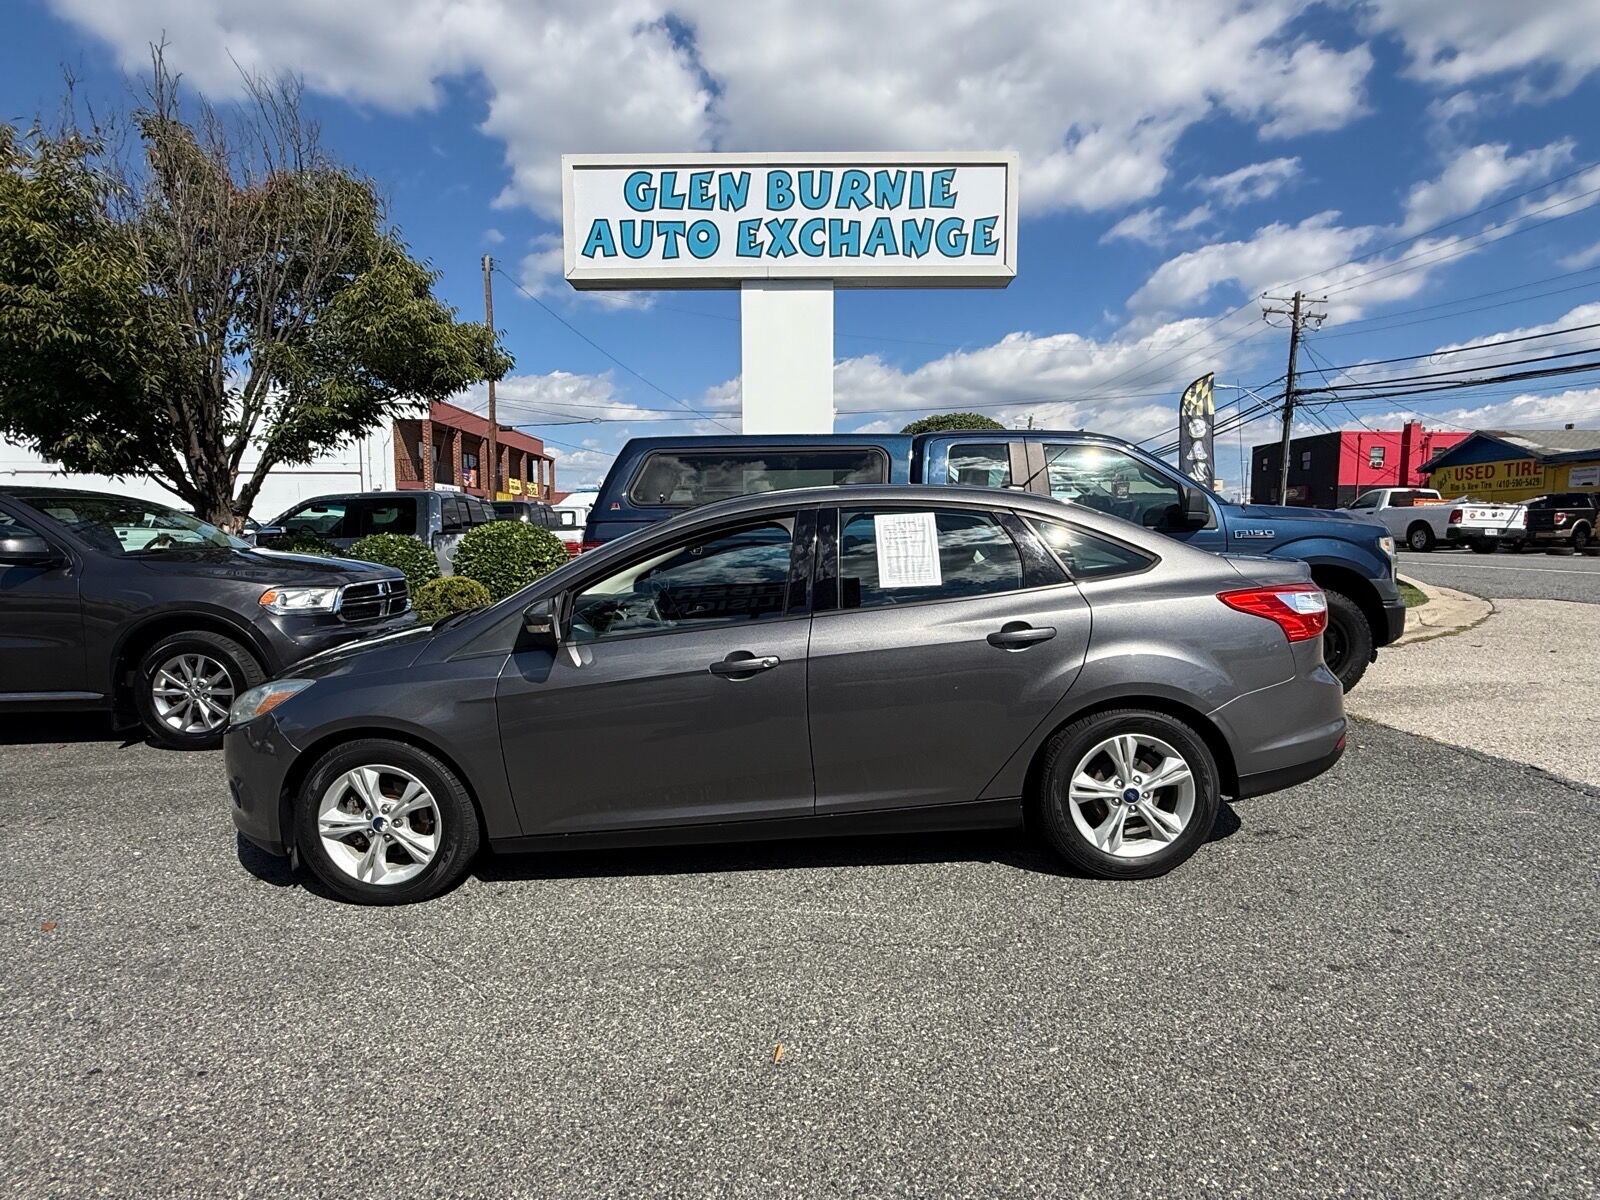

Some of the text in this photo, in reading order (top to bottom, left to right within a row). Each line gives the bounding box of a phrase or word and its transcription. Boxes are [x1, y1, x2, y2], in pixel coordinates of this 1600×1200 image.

[624, 168, 958, 212] GLEN BURNIE
[581, 215, 1000, 259] AUTO EXCHANGE
[1455, 461, 1542, 481] USED TIRE
